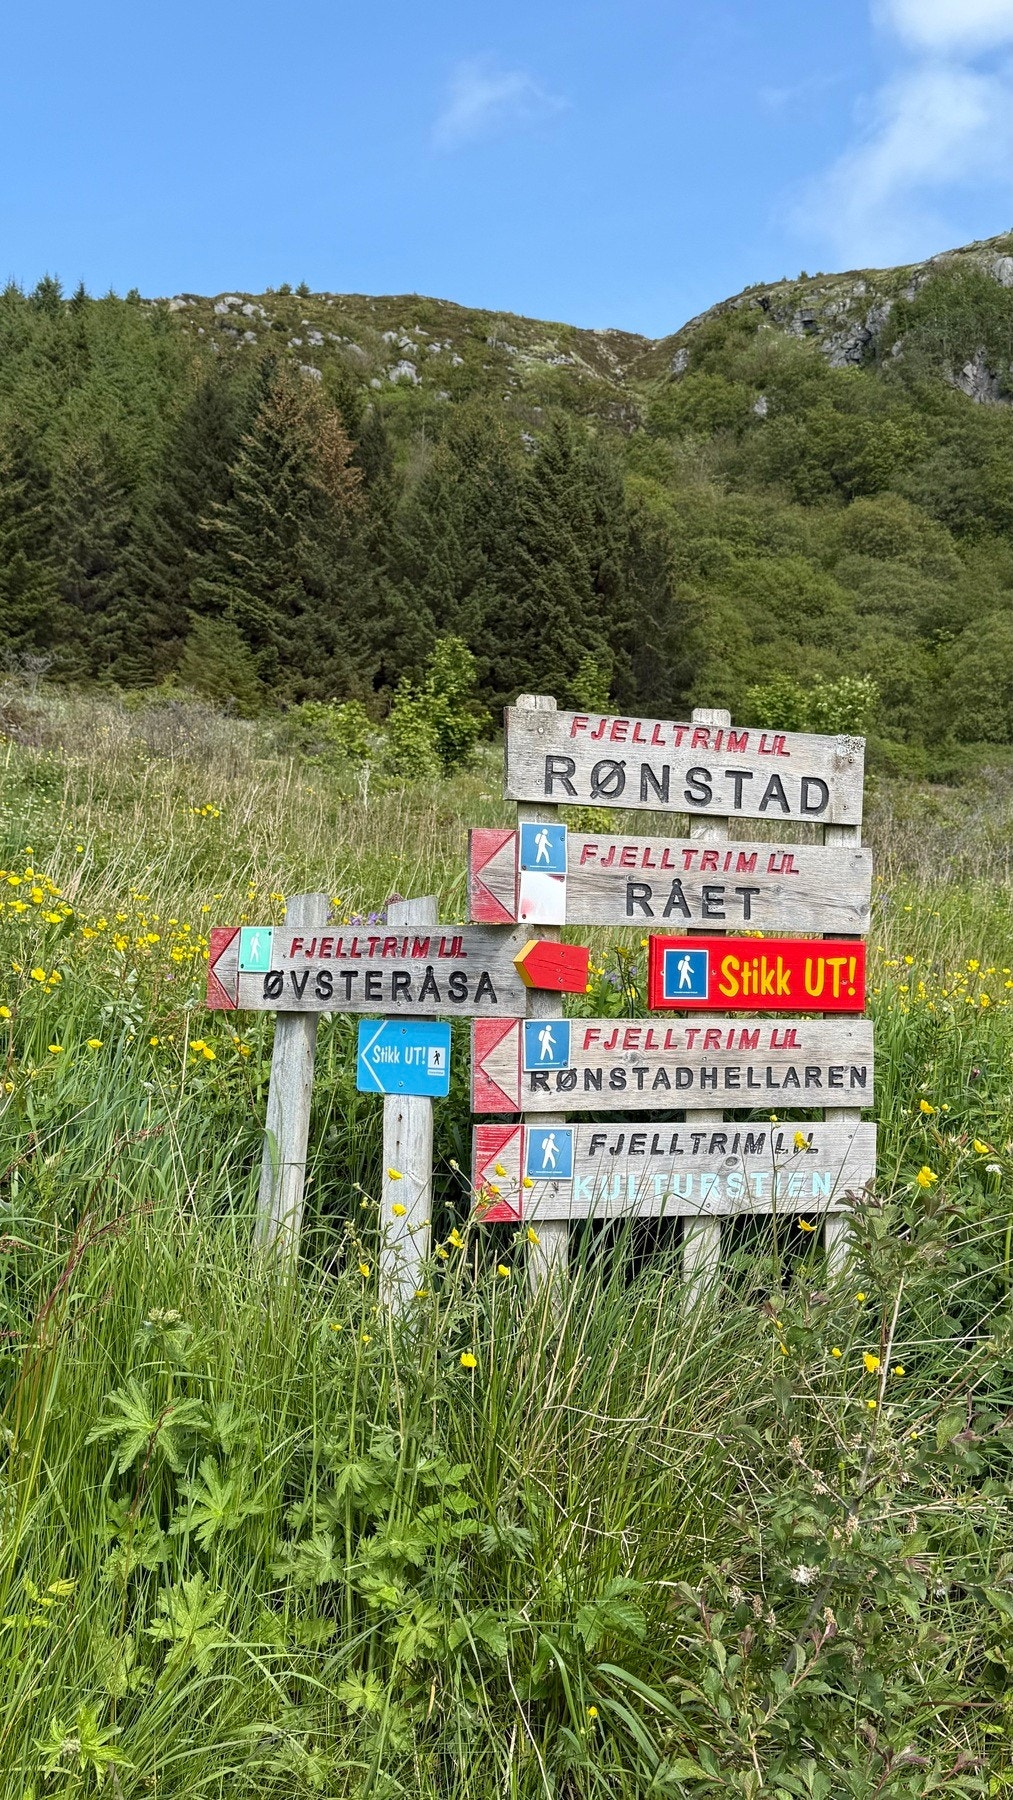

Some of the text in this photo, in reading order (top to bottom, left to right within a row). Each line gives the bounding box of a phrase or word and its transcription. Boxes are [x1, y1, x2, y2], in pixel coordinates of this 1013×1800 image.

[570, 716, 750, 754] FJELLTRIM
[544, 754, 830, 815] RØNSTAD
[579, 843, 759, 874] FJELLTRIM
[626, 878, 761, 920] RÅET
[289, 936, 431, 958] FJELLTRIM
[262, 965, 498, 1004] ØVSTERÅSA
[718, 955, 857, 998] Stikk UT!
[583, 1027, 760, 1050] FJELLTRIM
[372, 1044, 426, 1065] Stikk UT!
[531, 1065, 867, 1093] RØNSTADHELLAREN
[588, 1132, 767, 1156] FJELLTRIM
[573, 1171, 832, 1202] KULTURSTIEN
